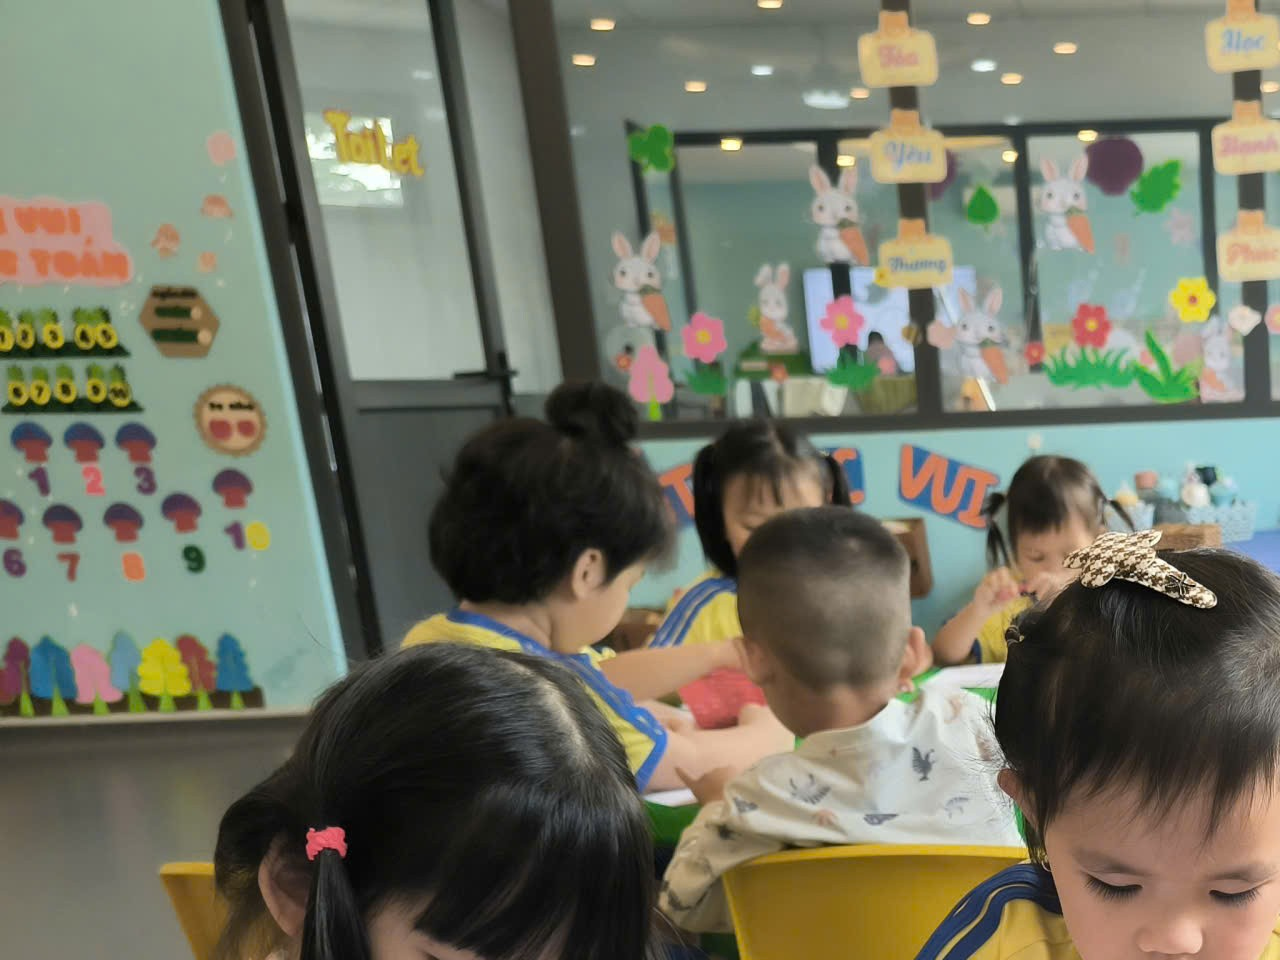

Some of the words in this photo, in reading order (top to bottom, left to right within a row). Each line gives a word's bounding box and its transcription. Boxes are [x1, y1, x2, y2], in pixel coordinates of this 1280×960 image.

[322, 110, 424, 176] Toilet
[28, 466, 49, 497] 1
[82, 464, 106, 496] 2
[134, 466, 157, 495] 3
[901, 443, 999, 528] VUI
[3, 549, 26, 578] 6
[57, 552, 80, 582] 7
[182, 544, 206, 574] 9
